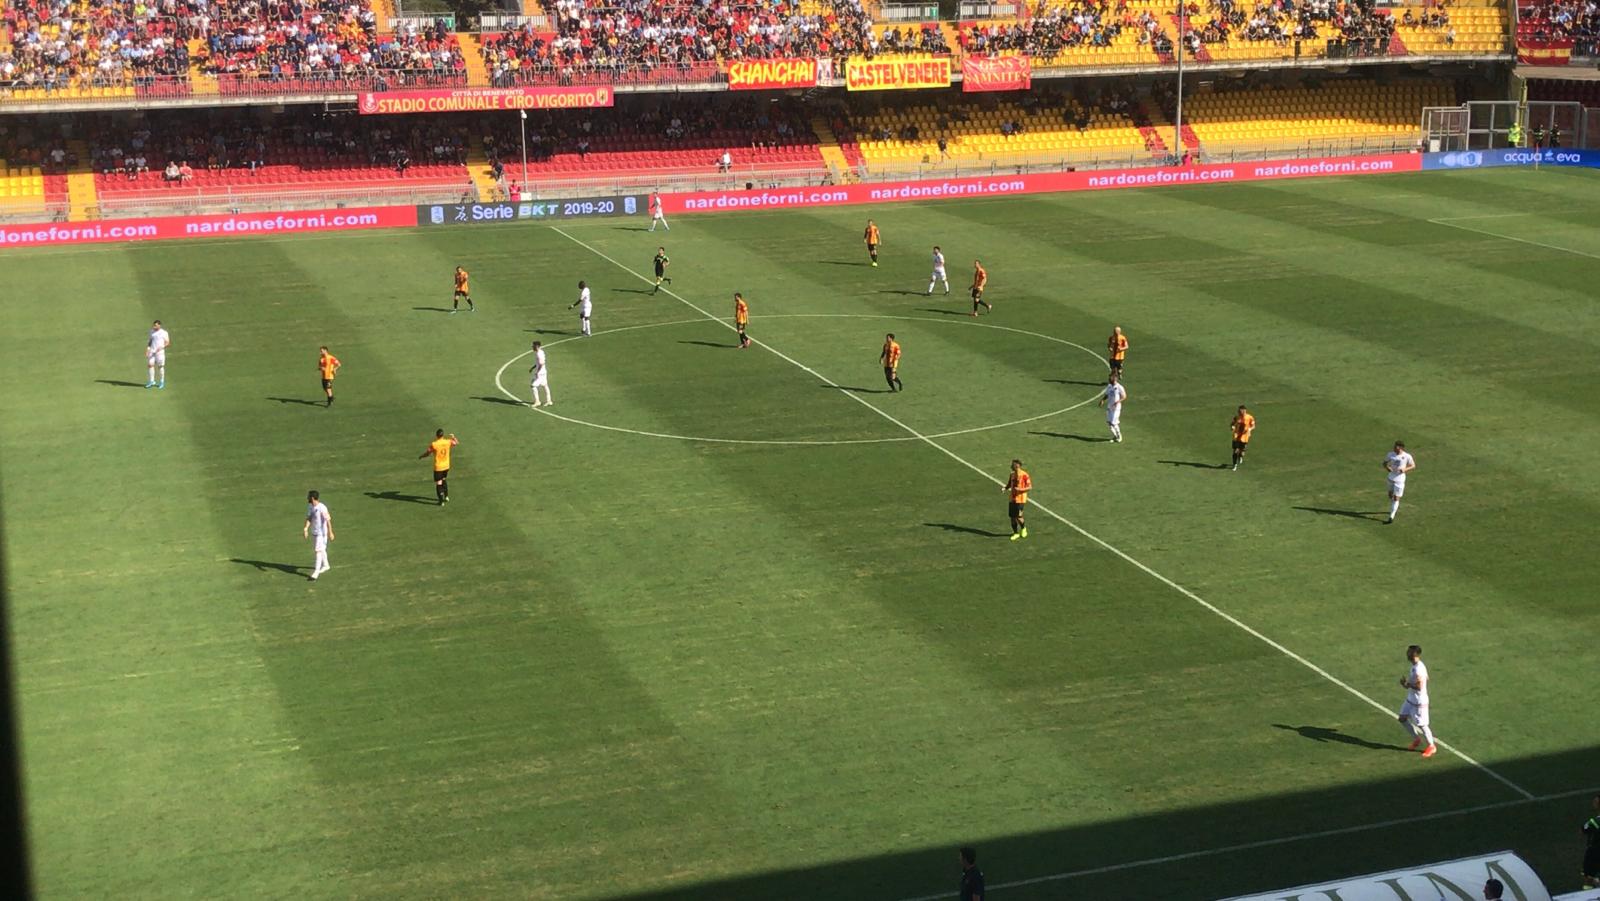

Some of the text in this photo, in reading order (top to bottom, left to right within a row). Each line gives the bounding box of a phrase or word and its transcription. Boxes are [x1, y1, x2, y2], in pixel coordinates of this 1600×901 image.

[729, 61, 814, 85] SHANGHAI
[379, 93, 595, 113] STADIO COMUNALE CIRO VIGORITO
[1504, 152, 1580, 164] acqua eva
[1088, 168, 1234, 186] nardoneforni.com
[1255, 160, 1393, 176] nardoneforni.com
[871, 180, 1024, 199] nardoneforni.com
[685, 191, 848, 209] nardoneforni.com
[472, 201, 615, 220] Serie BKT 2019-20
[186, 213, 378, 233] nardoneforni.com
